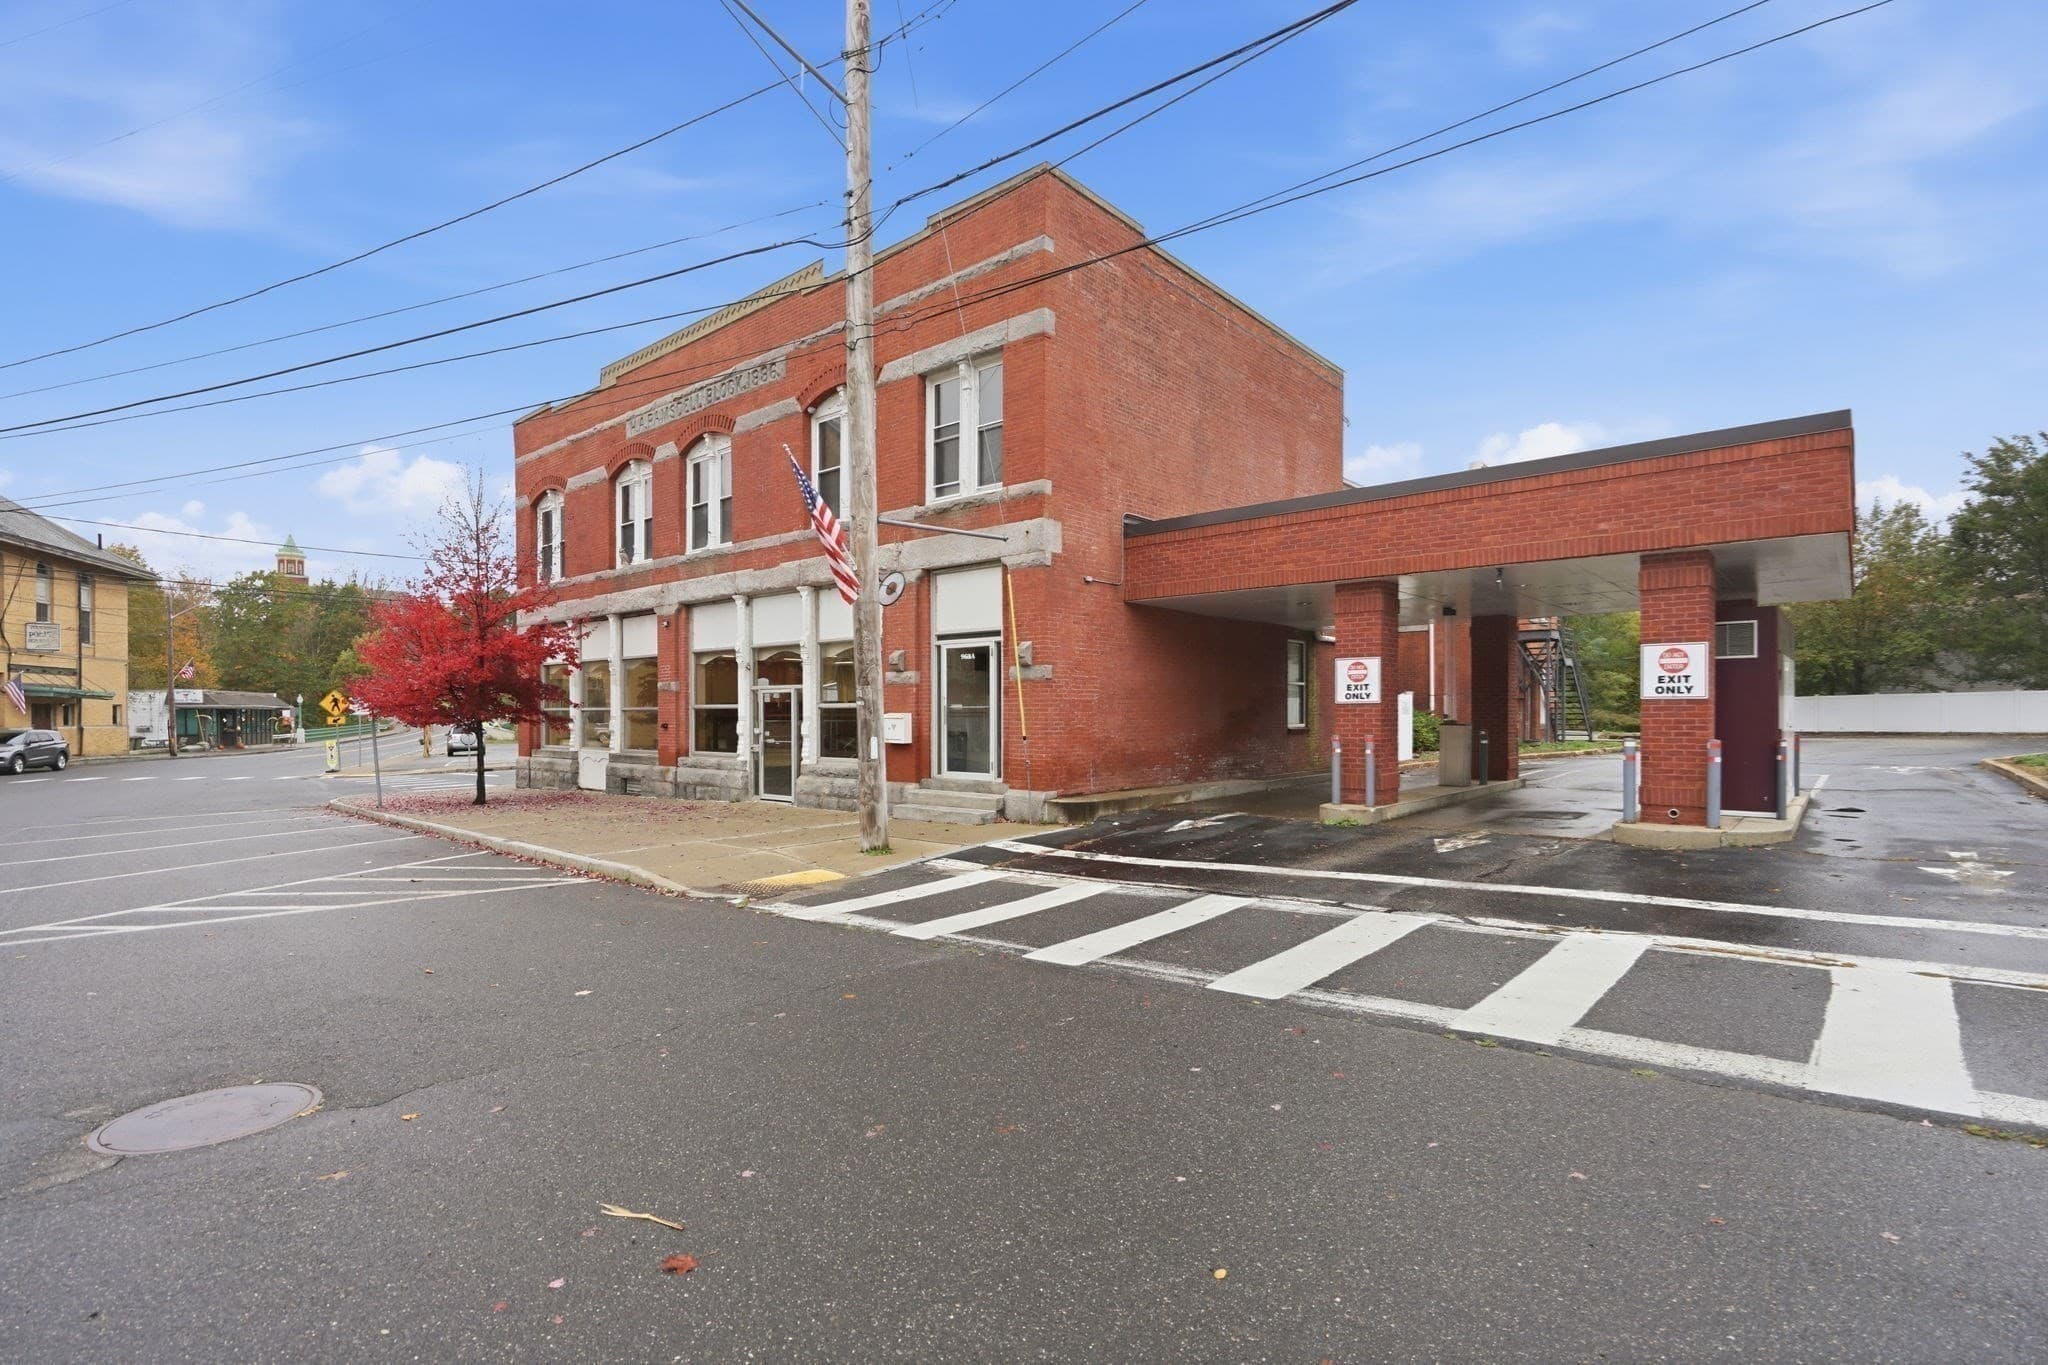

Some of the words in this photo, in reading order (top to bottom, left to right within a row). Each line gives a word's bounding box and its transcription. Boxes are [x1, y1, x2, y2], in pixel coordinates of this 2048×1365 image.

[1657, 675, 1692, 684] EXIT
[1346, 683, 1369, 691] EXIT
[1654, 685, 1694, 695] ONLY
[1344, 692, 1371, 700] ONLY
